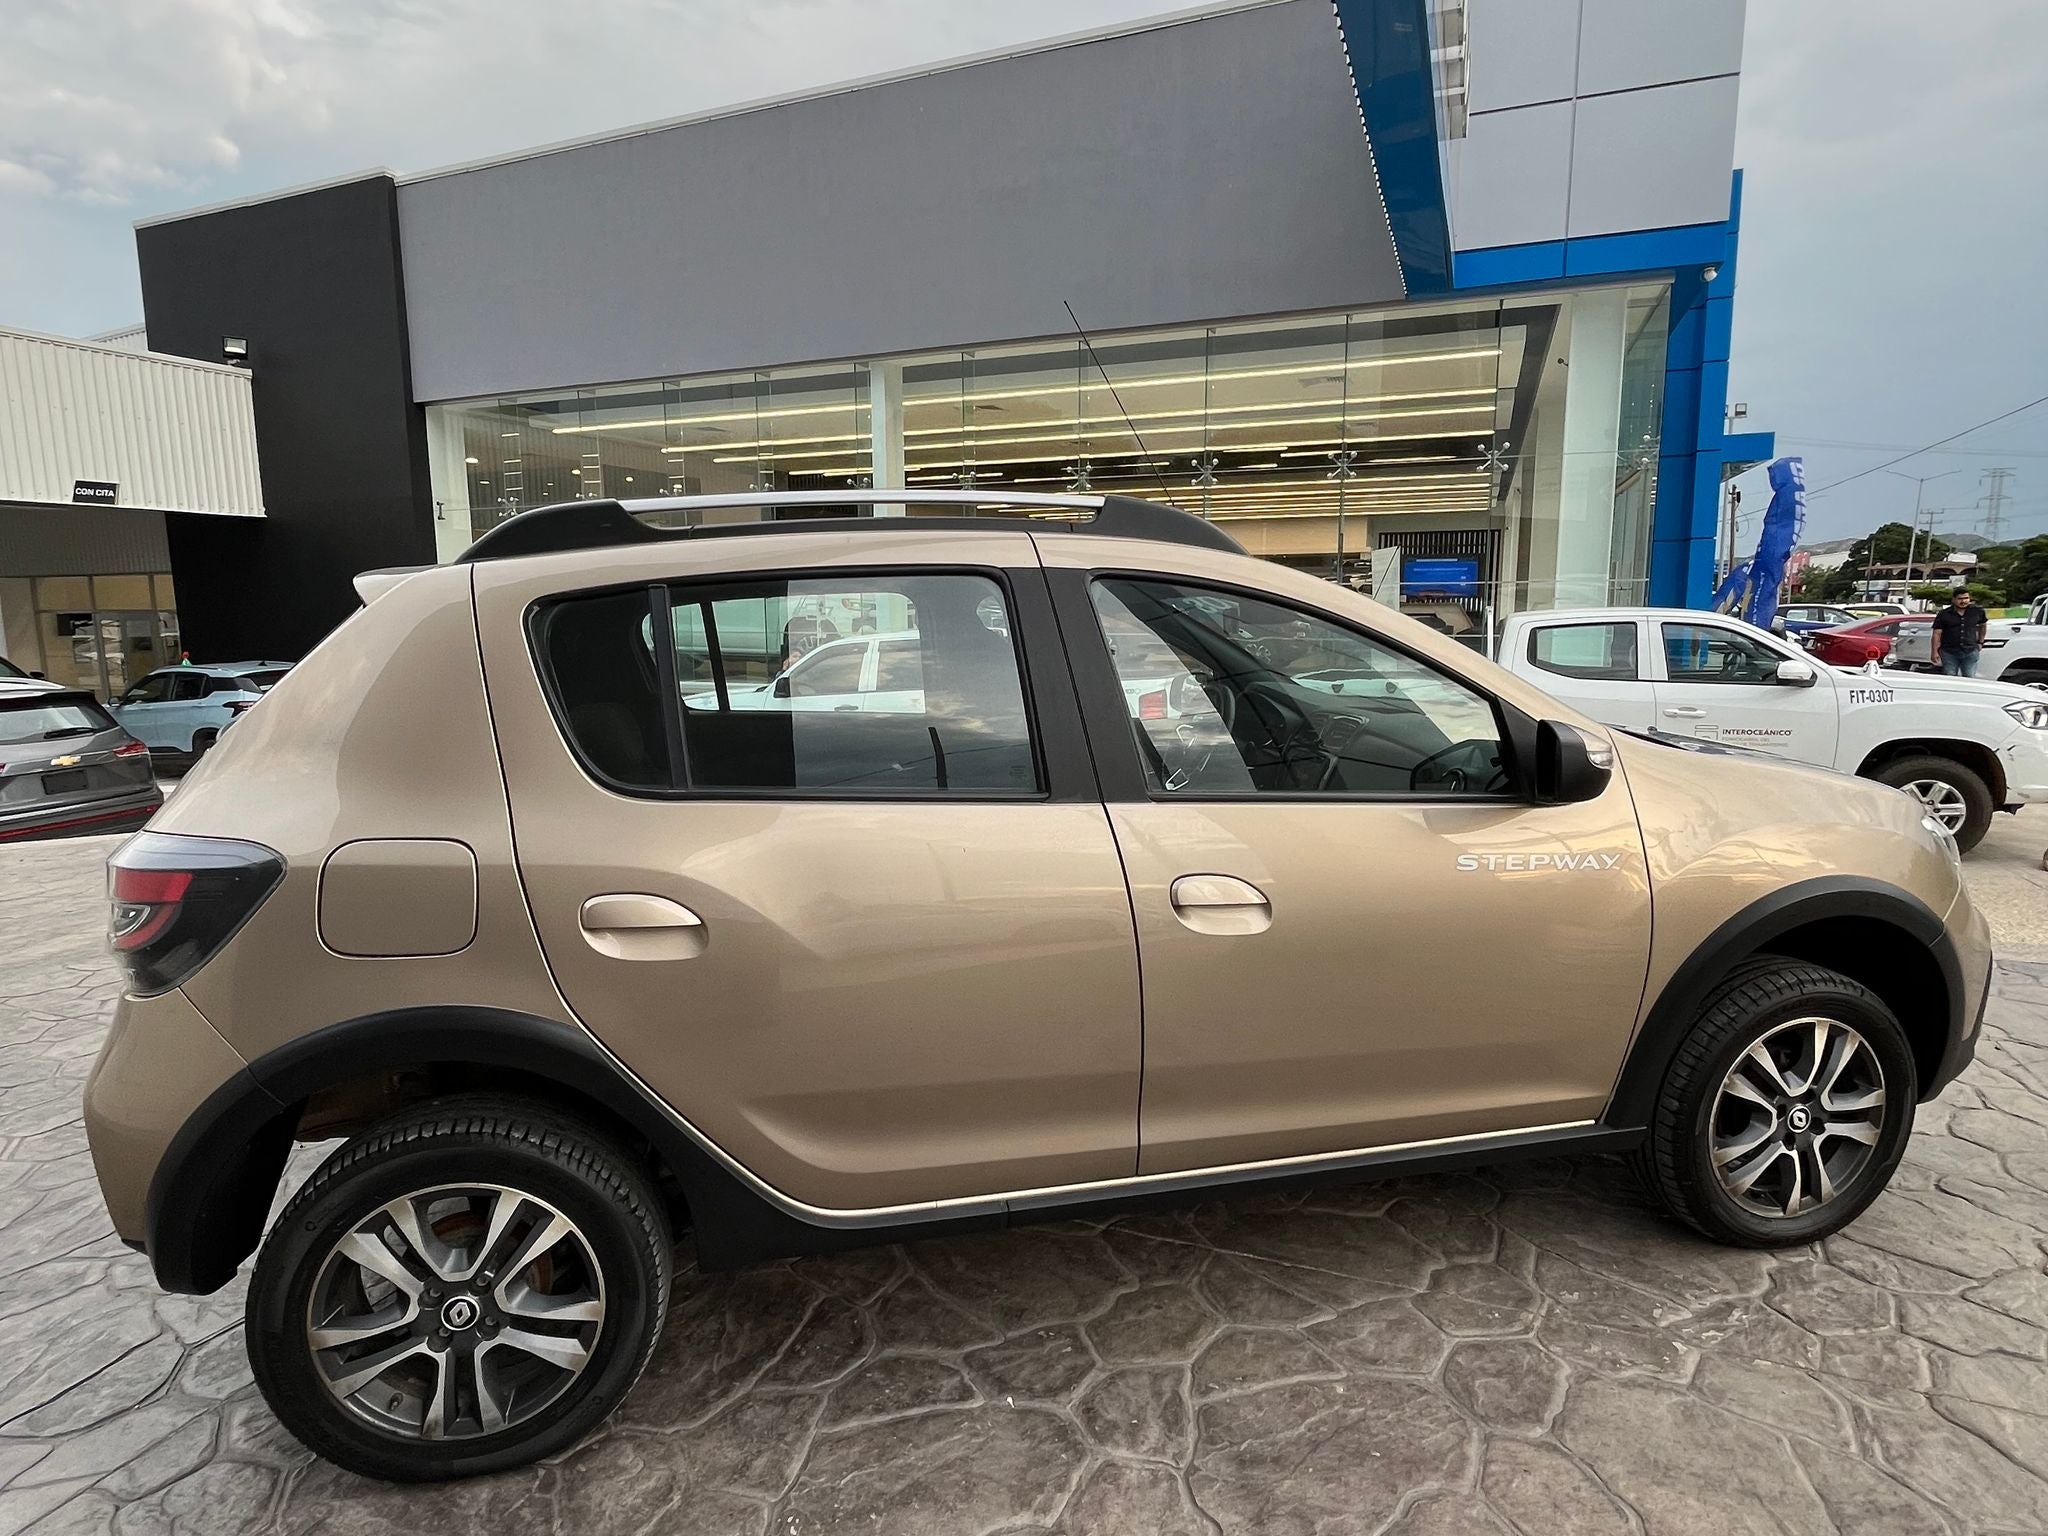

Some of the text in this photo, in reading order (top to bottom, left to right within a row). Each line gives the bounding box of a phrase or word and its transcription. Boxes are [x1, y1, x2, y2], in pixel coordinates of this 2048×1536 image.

[75, 487, 115, 497] CON CITA
[1849, 689, 1894, 704] FIT-0307
[1456, 854, 1621, 871] STEPWAY
